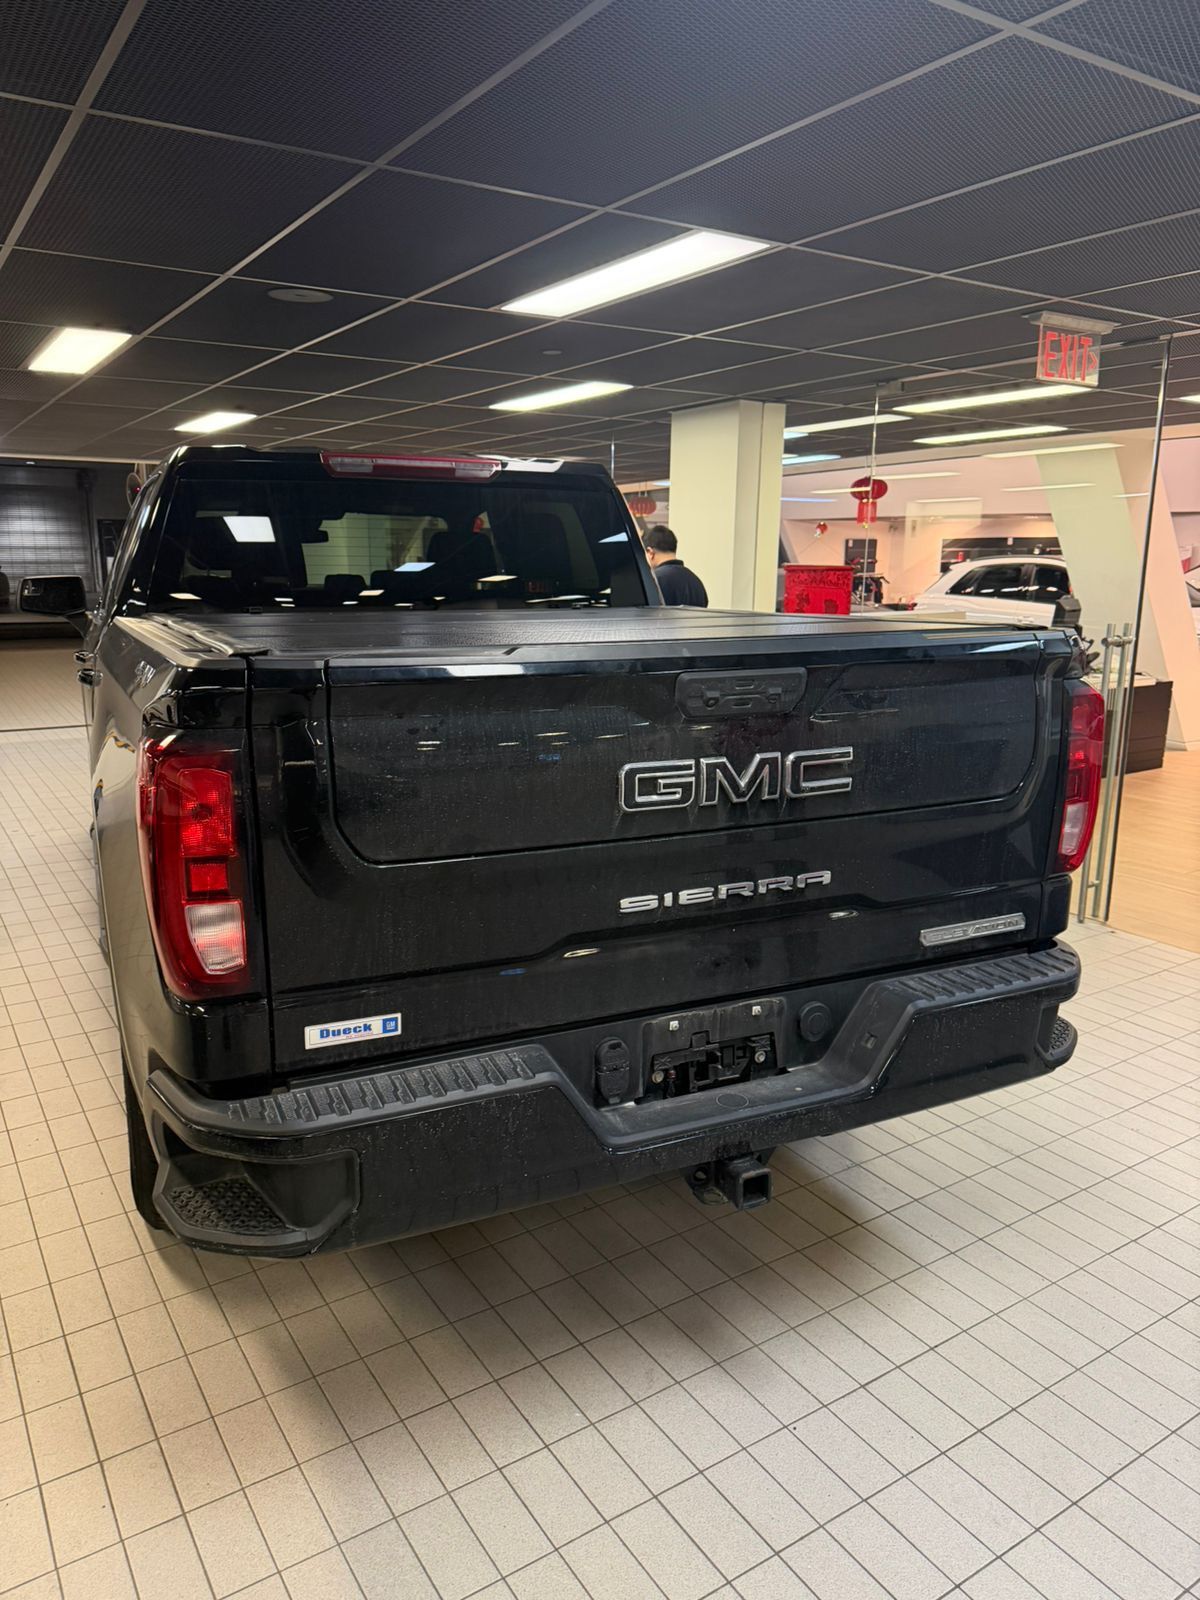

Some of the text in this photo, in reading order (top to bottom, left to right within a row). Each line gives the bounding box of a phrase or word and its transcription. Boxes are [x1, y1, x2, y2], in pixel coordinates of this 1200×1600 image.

[1043, 331, 1093, 381] EXIT
[618, 746, 853, 812] GMC
[619, 870, 831, 913] SIERRA
[320, 1023, 372, 1039] Dueck
